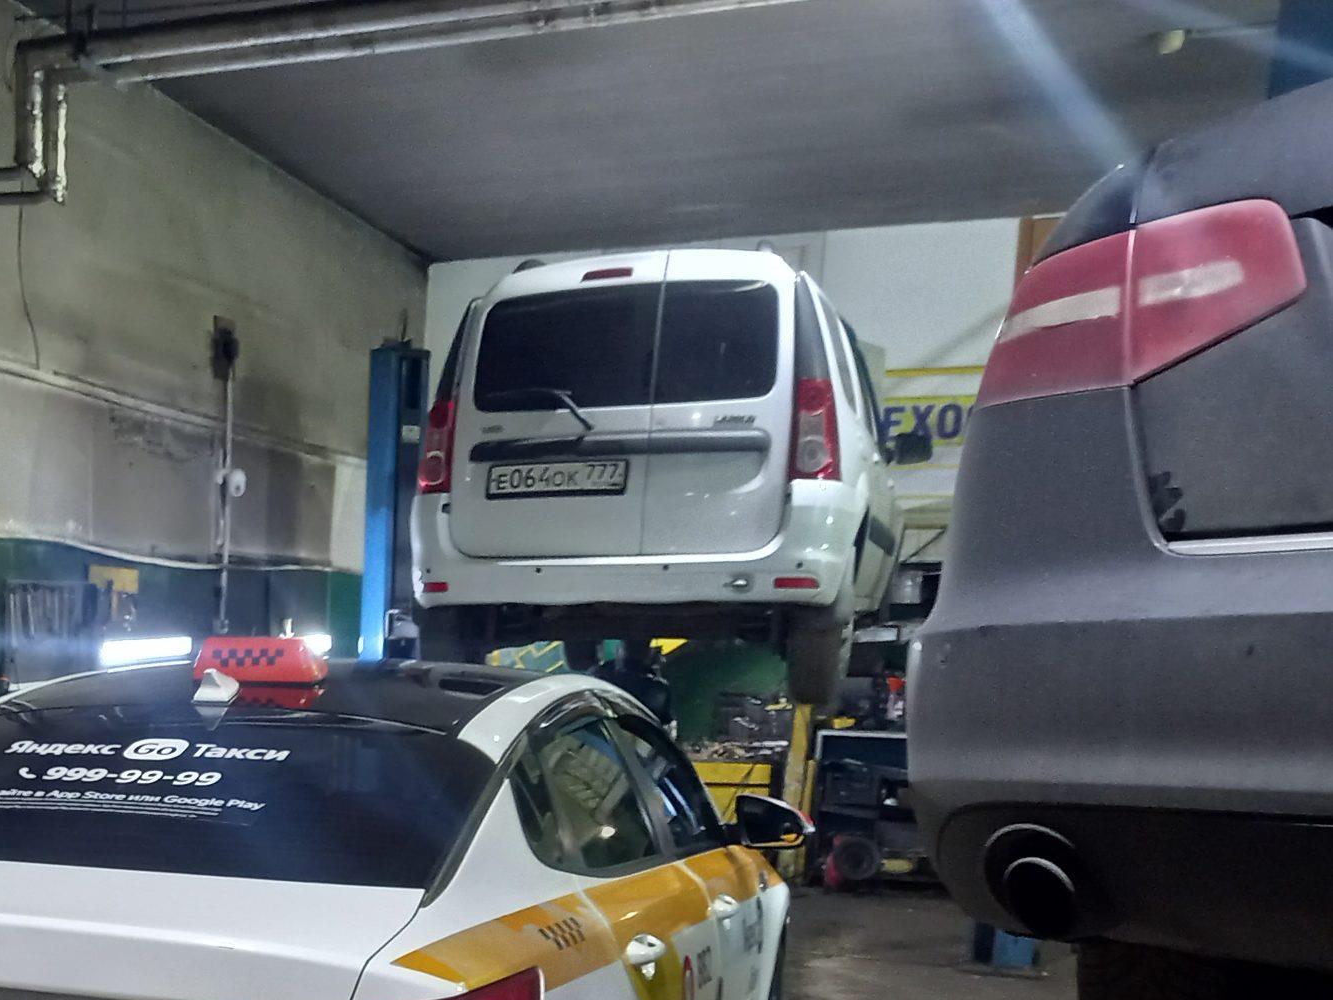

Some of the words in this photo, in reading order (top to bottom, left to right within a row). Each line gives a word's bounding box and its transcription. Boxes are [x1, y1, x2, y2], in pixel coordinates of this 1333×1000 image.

[880, 403, 974, 442] ЕХО
[585, 463, 619, 480] 777
[4, 740, 122, 757] Яндекс
[192, 743, 292, 762] Такси
[41, 766, 223, 787] 999-99-99
[48, 789, 81, 801] App
[83, 789, 127, 801] Store
[127, 794, 164, 803] или
[164, 795, 225, 809] Google
[225, 800, 267, 812] Play
